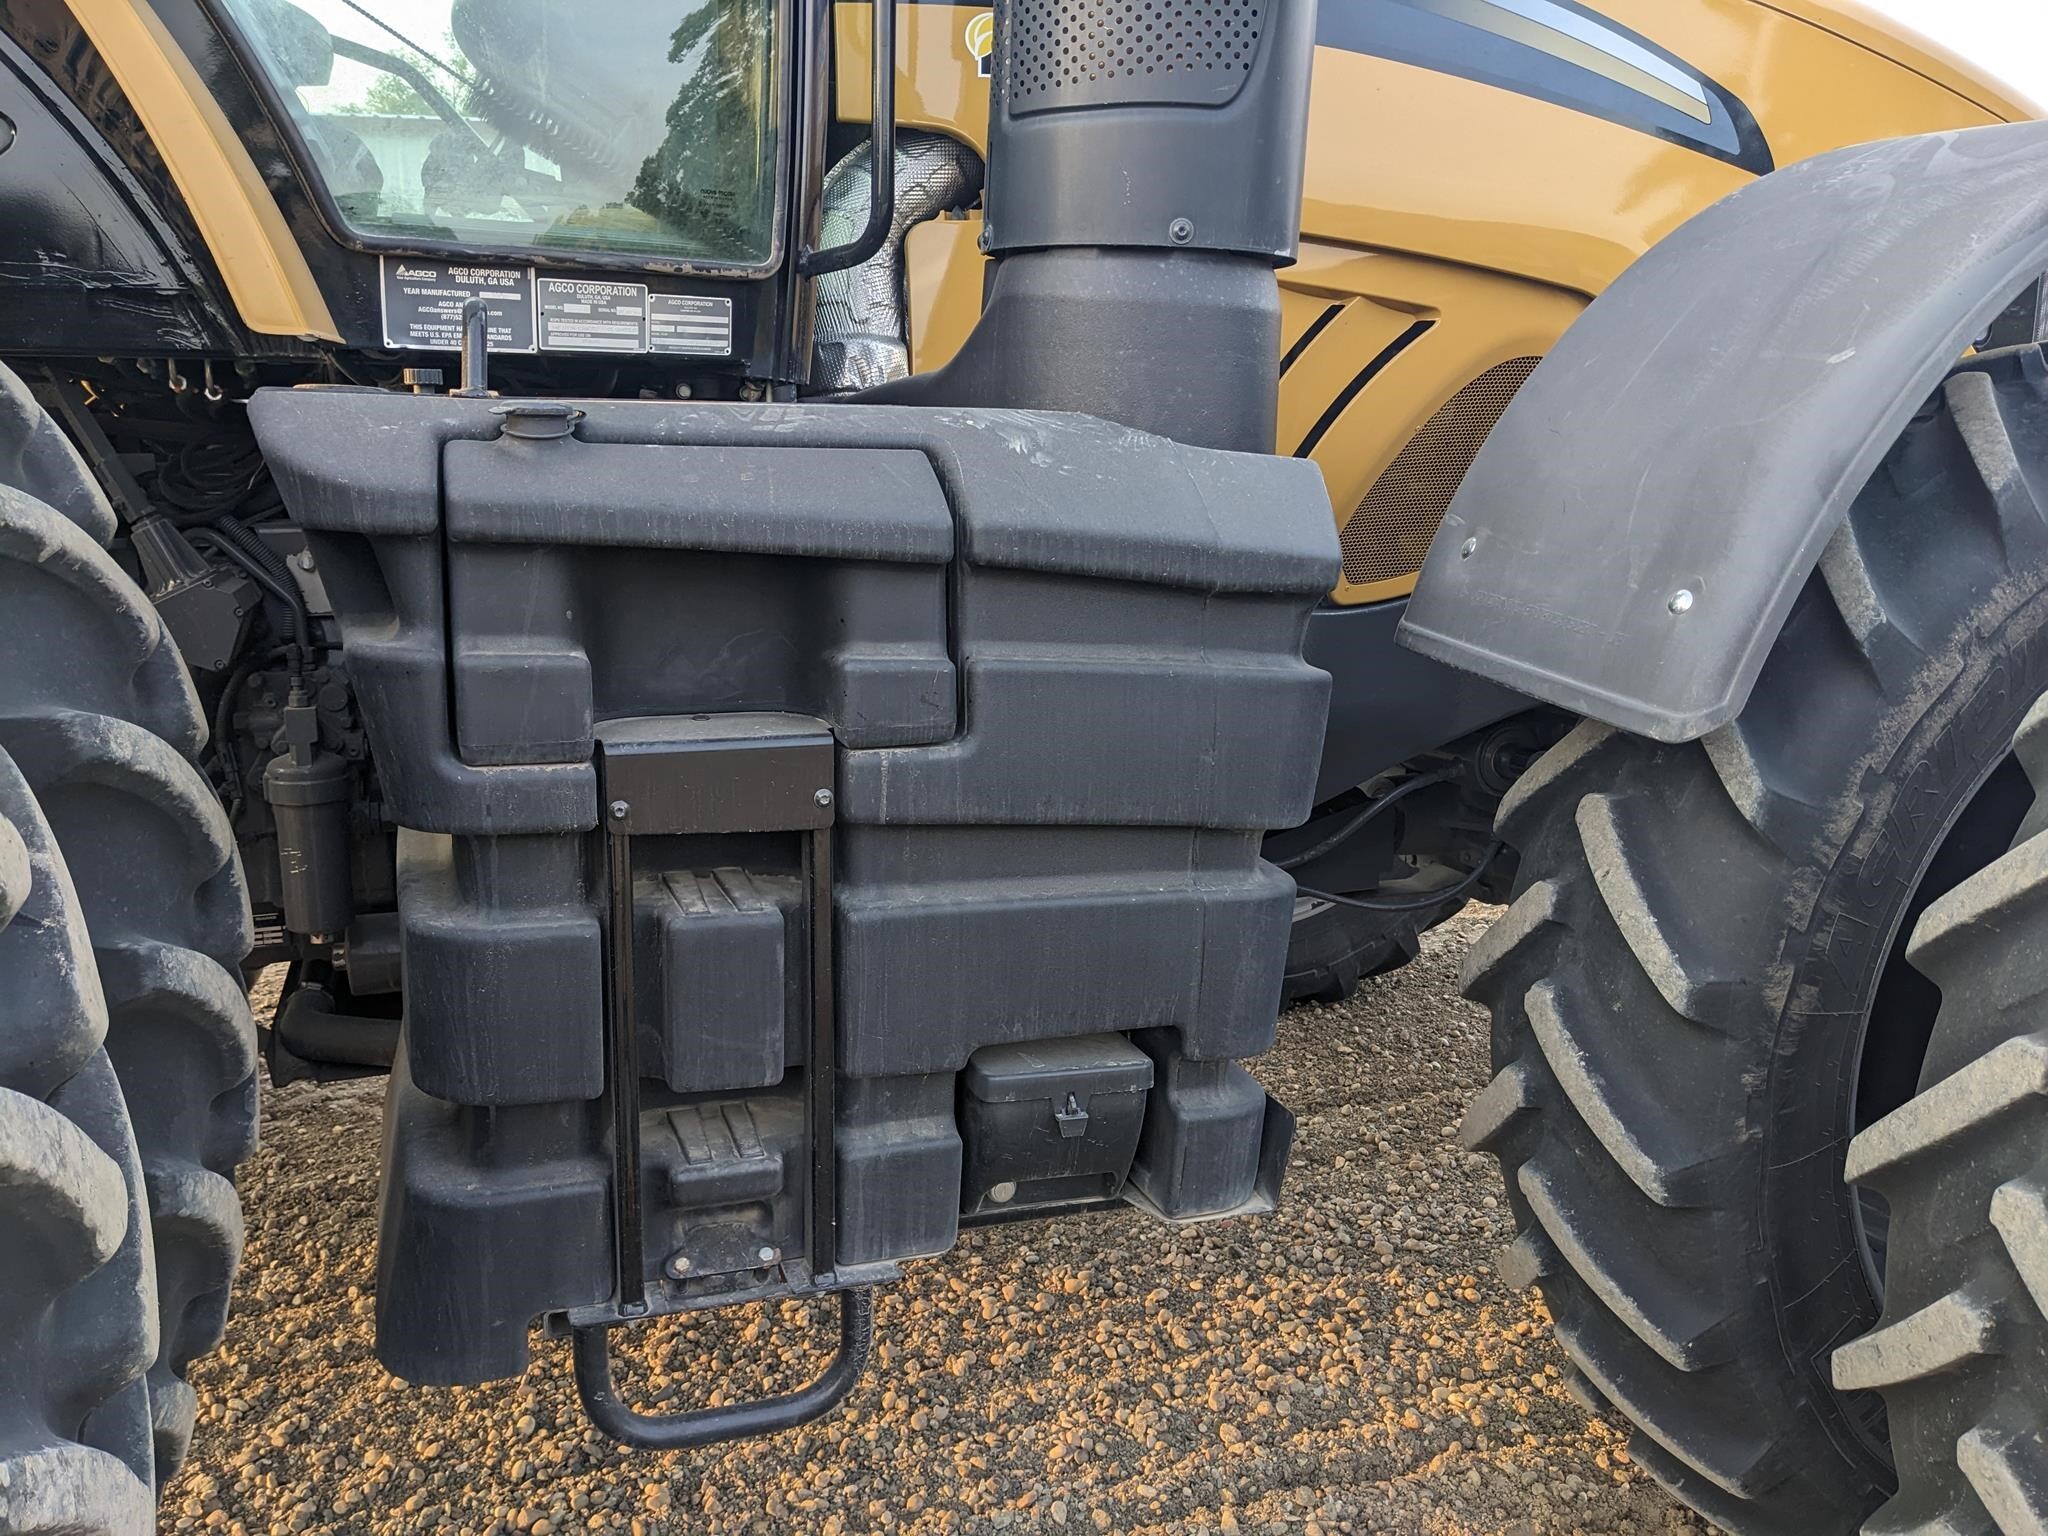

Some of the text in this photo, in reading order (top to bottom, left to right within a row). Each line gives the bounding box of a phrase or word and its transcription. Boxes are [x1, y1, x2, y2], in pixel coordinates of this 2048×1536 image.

[448, 267, 521, 279] AGCO CORPORATION
[455, 276, 486, 285] DULUTH,
[422, 288, 470, 297] MANUFACTURED
[548, 282, 637, 296] AGCO CORPORATION
